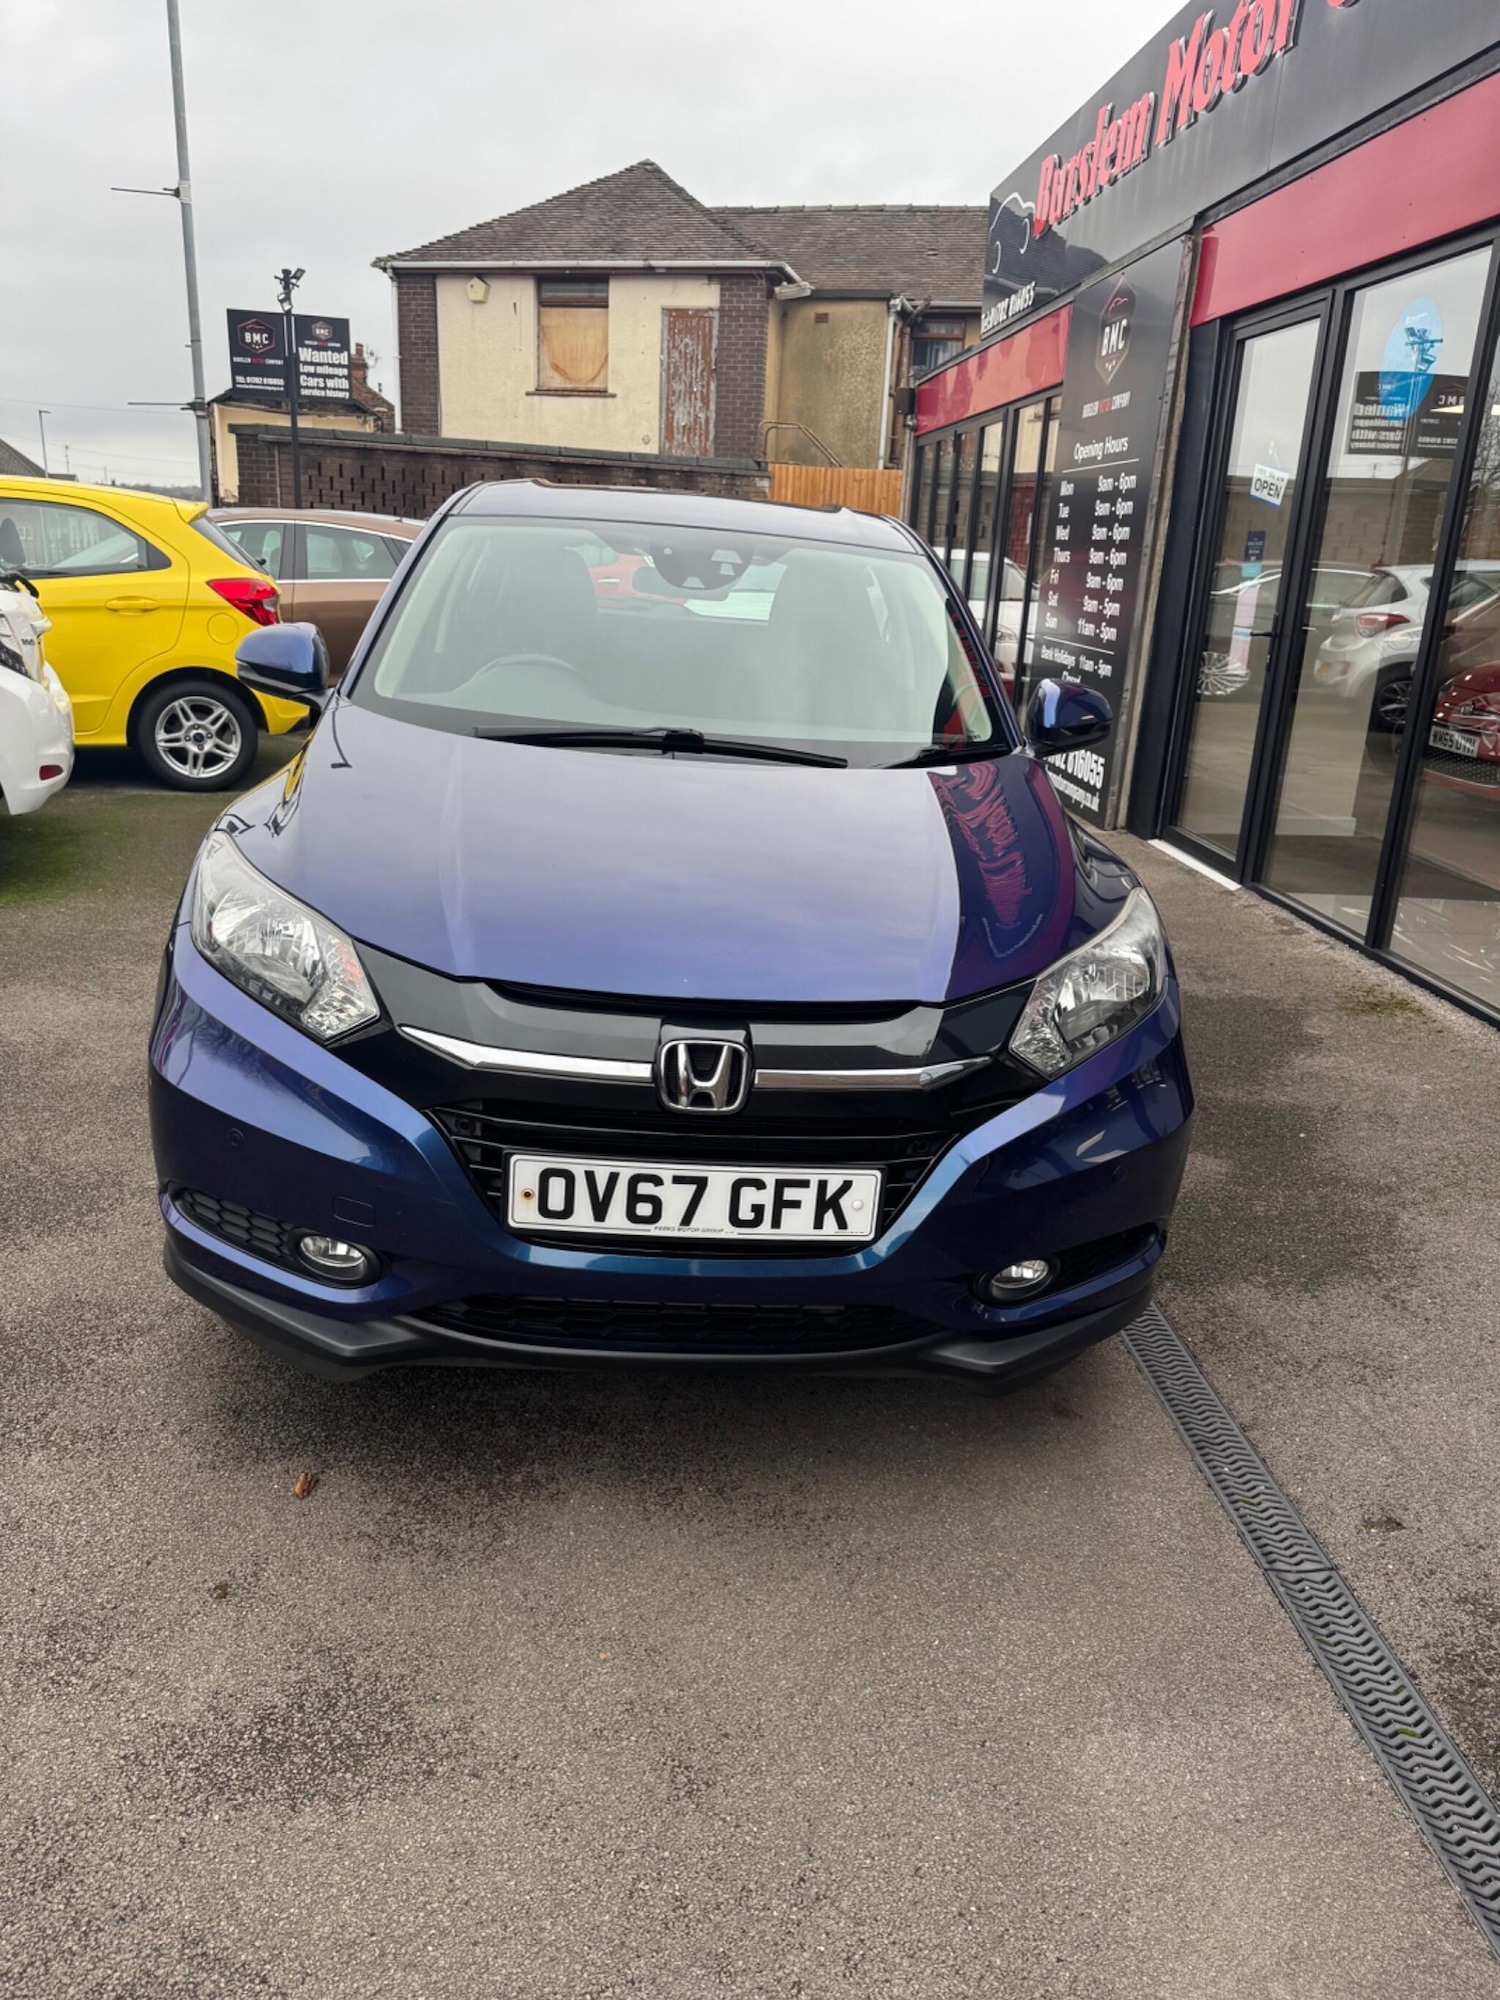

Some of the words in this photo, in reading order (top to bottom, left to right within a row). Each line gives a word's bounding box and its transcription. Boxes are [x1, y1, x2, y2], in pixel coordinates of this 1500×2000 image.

[1032, 91, 1155, 239] Burslem
[1155, 0, 1299, 147] Motor
[244, 331, 269, 344] BMC
[1101, 318, 1128, 357] BMC
[298, 347, 349, 365] Wanted
[299, 363, 315, 374] Low
[316, 365, 348, 377] mileage
[299, 375, 325, 388] Cars
[325, 378, 349, 389] with
[325, 390, 349, 399] history
[1074, 440, 1104, 463] Opening
[1104, 436, 1129, 456] Hours
[1060, 480, 1075, 496] Mon
[1098, 475, 1114, 492] 9am
[1119, 472, 1137, 494] 6pm
[1254, 478, 1282, 499] OPEN
[1058, 503, 1070, 518] Tue
[1095, 499, 1111, 517] 9am
[1115, 497, 1134, 519] 6pm
[1056, 525, 1070, 541] Wed
[1091, 523, 1108, 541] 9am
[1112, 522, 1131, 545] 6pm
[1053, 547, 1071, 563] Thurs
[1089, 547, 1105, 565] 9am
[1109, 547, 1127, 570] 6pm
[1050, 568, 1060, 585] Fri
[1086, 571, 1102, 590] 9am
[1106, 572, 1124, 595] 6pm
[1047, 590, 1059, 607] Sat
[1083, 594, 1099, 613] 9am
[1103, 597, 1121, 619] 5pm
[1045, 612, 1058, 629] Sun
[1077, 617, 1096, 637] 11am
[1100, 621, 1117, 643] 5pm
[1041, 644, 1054, 660] Bank
[1054, 647, 1076, 669] Holidays
[1079, 654, 1095, 673] 11am
[1097, 659, 1113, 679] 5pm
[1067, 749, 1106, 790] 816055
[537, 1167, 709, 1227] OV67
[728, 1177, 853, 1230] GFK
